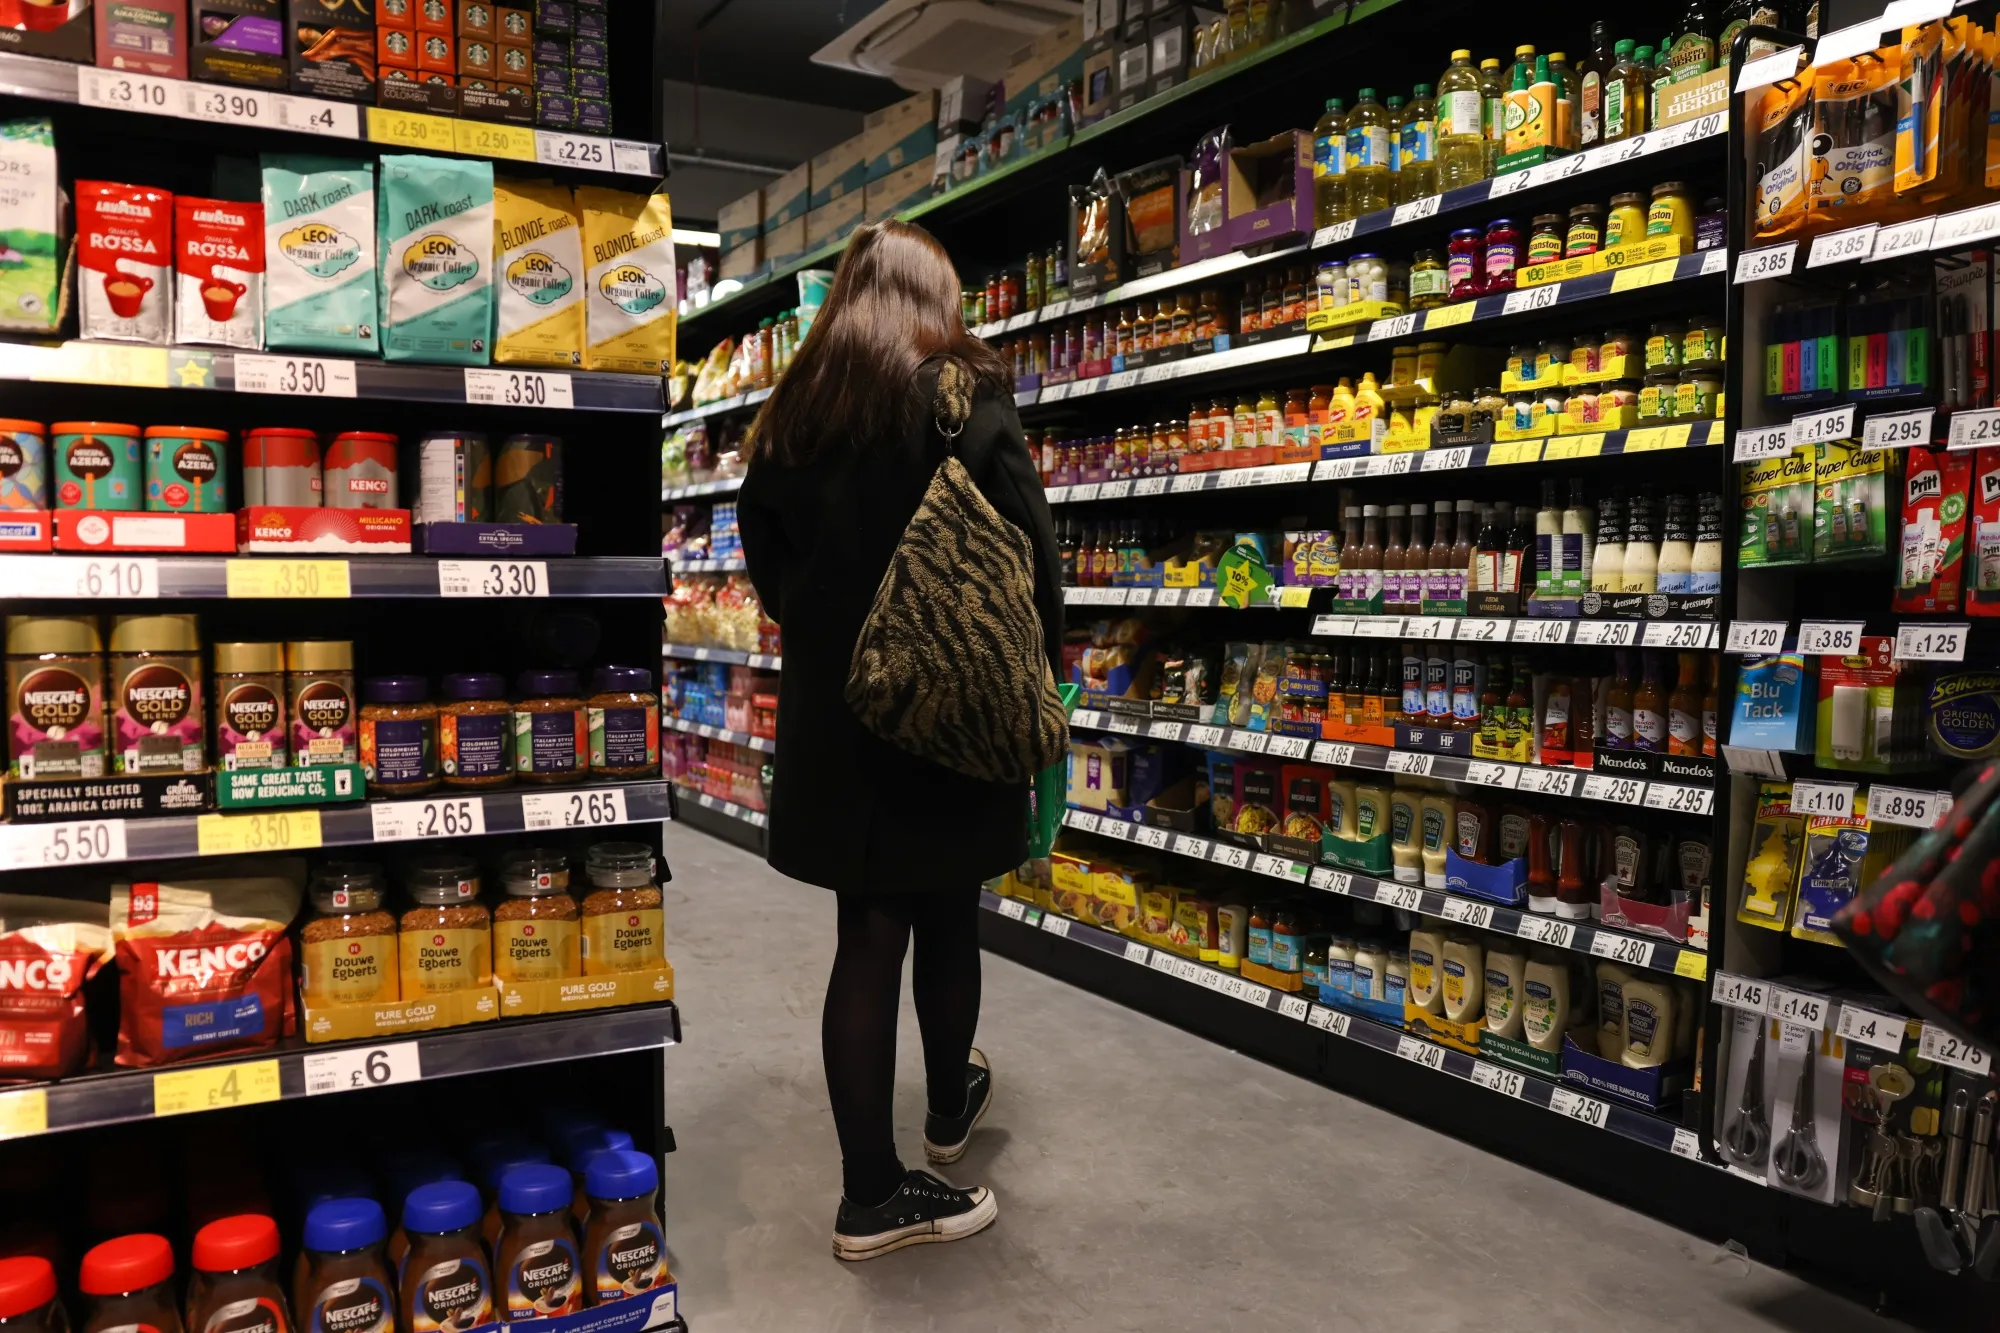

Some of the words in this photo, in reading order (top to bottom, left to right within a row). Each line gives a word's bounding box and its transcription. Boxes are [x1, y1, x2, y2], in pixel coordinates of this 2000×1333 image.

[383, 89, 428, 104] COLOMBIA
[1674, 79, 1726, 104] FILIPPO
[464, 94, 486, 106] HOUSE
[487, 96, 510, 108] BLEND
[1667, 87, 1729, 118] BERIO
[309, 108, 335, 128] £4
[1683, 114, 1720, 143] £4.90
[558, 140, 603, 163] £2.25
[1620, 136, 1646, 160] £2
[1845, 148, 1883, 160] Cristal
[1562, 154, 1586, 177] £2
[1834, 155, 1893, 173] Original
[1509, 170, 1531, 192] £2
[1765, 172, 1798, 195] Original
[95, 200, 152, 218] LAVAZZA
[284, 192, 321, 218] DARK
[322, 183, 353, 205] roast
[192, 209, 245, 226] LAVAZZA
[405, 207, 442, 232] DARK
[444, 193, 474, 217] roast
[1253, 218, 1270, 230] ASDA
[302, 230, 338, 245] LEON
[500, 217, 547, 251] BLONDE
[548, 215, 572, 233] roast
[422, 241, 456, 256] LEON
[593, 231, 639, 263] BLONDE
[641, 225, 666, 246] roast
[1826, 234, 1865, 258] £3.85
[408, 260, 439, 276] Organic
[443, 260, 472, 275] Coffee
[525, 259, 553, 273] LEON
[1604, 252, 1624, 267] 100
[1752, 252, 1788, 275] £3.85
[511, 275, 541, 289] Organic
[542, 277, 567, 290] Coffee
[617, 271, 646, 284] LEON
[1526, 268, 1544, 282] 100
[1936, 266, 1986, 295] Sharpie
[605, 284, 634, 299] Organic
[635, 286, 661, 301] Coffee
[1687, 339, 1704, 348] APPLE
[505, 374, 545, 405] £3.50
[1808, 415, 1845, 438] £1.95
[1881, 419, 1922, 442] £2.95
[1752, 432, 1786, 453] £1.95
[70, 456, 111, 467] AZERA
[177, 460, 215, 471] AZERA
[1815, 458, 1849, 476] Super
[1850, 450, 1880, 468] Glue
[1744, 468, 1780, 485] Super
[1783, 459, 1812, 476] Glue
[350, 480, 387, 492] KENCO
[1910, 477, 1938, 495] Pritt
[254, 528, 292, 538] KENCO
[483, 564, 536, 596] £3.30
[1613, 596, 1643, 609] dressings
[1681, 596, 1714, 611] dressings
[1422, 620, 1441, 638] £1
[1475, 621, 1497, 640] £2
[1532, 622, 1563, 642] £1.40
[1596, 623, 1629, 645] £2.50
[1665, 624, 1700, 647] £2.50
[1743, 628, 1777, 647] £1.20
[1815, 630, 1853, 648] £3.85
[1916, 634, 1958, 654] £1.25
[1403, 666, 1420, 680] HP
[1428, 667, 1444, 681] HP
[1454, 669, 1472, 685] HP
[1750, 682, 1780, 699] Blu
[31, 703, 81, 718] GOLD
[136, 700, 183, 713] GOLD
[1743, 702, 1783, 719] Tack
[1942, 709, 1995, 721] ORIGINAL
[235, 713, 272, 724] GOLD
[308, 710, 343, 721] GOLD
[1941, 718, 1995, 730] GOLDEN
[1410, 731, 1423, 742] HP
[1600, 754, 1647, 770] Nando's
[1663, 760, 1714, 778] Nando's
[231, 775, 258, 787] SAME
[261, 773, 292, 786] GREAT
[294, 771, 326, 784] TASTE.
[1485, 766, 1506, 786] £2
[17, 787, 81, 801] SPECIALLY
[85, 784, 141, 798] SELECTED
[1667, 788, 1705, 813] £2.95
[16, 804, 45, 815] 100%
[47, 801, 98, 813] ARABICA
[102, 798, 144, 810] COFFEE
[565, 793, 616, 826] £2.65
[1808, 791, 1844, 812] £1.10
[1885, 796, 1926, 819] £8.95
[417, 801, 473, 836] £2.65
[1759, 804, 1782, 818] Little
[1111, 821, 1125, 838] 95p
[1424, 820, 1441, 829] SALAD
[43, 823, 110, 864] £5.50
[1187, 840, 1203, 857] 75p
[1226, 849, 1244, 867] 75p
[1269, 859, 1286, 877] 75p
[616, 927, 650, 938] Douwe
[1537, 921, 1568, 946] £2.80
[511, 937, 548, 947] Douwe
[614, 936, 652, 950] Egberts
[155, 941, 266, 977] KENCO
[420, 947, 459, 958] Douwe
[509, 947, 551, 960] Egberts
[1612, 938, 1647, 964] £2.80
[334, 955, 374, 967] Douwe
[419, 957, 461, 971] Egberts
[332, 965, 377, 981] Egberts
[1414, 967, 1428, 975] REAL
[560, 984, 585, 995] PURE
[588, 981, 617, 992] GOLD
[1728, 983, 1762, 1005] £1.45
[375, 1009, 402, 1021] PURE
[406, 1004, 436, 1016] GOLD
[1527, 1000, 1547, 1009] VEGAN
[1632, 1000, 1652, 1014] HEINZ
[1784, 999, 1819, 1022] £1.45
[185, 1011, 214, 1028] RICH
[376, 1019, 407, 1027] MEDIUM
[408, 1014, 435, 1023] ROAST
[1632, 1018, 1648, 1028] GOOD
[193, 1031, 217, 1042] INSTANT
[218, 1028, 240, 1038] COFFEE
[1783, 1031, 1804, 1039] scissor
[1859, 1021, 1876, 1039] £4
[1886, 1031, 1898, 1039] Now
[1784, 1035, 1794, 1043] set
[1940, 1038, 1983, 1065] £2.75
[351, 1050, 391, 1087] £6
[208, 1068, 242, 1106] £4
[1489, 1070, 1519, 1096] £3.15
[1568, 1071, 1588, 1083] HEINZ
[1591, 1077, 1606, 1087] 100%
[1606, 1080, 1619, 1091] FREE
[1619, 1084, 1635, 1098] RANGE
[1636, 1090, 1650, 1101] EGGS
[1570, 1097, 1602, 1125] £2.50
[611, 1242, 656, 1264] NESCAFÉ
[616, 1254, 655, 1270] ORIGINAL
[523, 1259, 569, 1283] NESCAFÉ
[528, 1272, 568, 1289] ORIGINAL
[428, 1279, 479, 1304] NESCAFÉ
[602, 1290, 621, 1298] DECAF
[433, 1293, 476, 1310] ORIGINAL
[512, 1309, 533, 1318] DECAF
